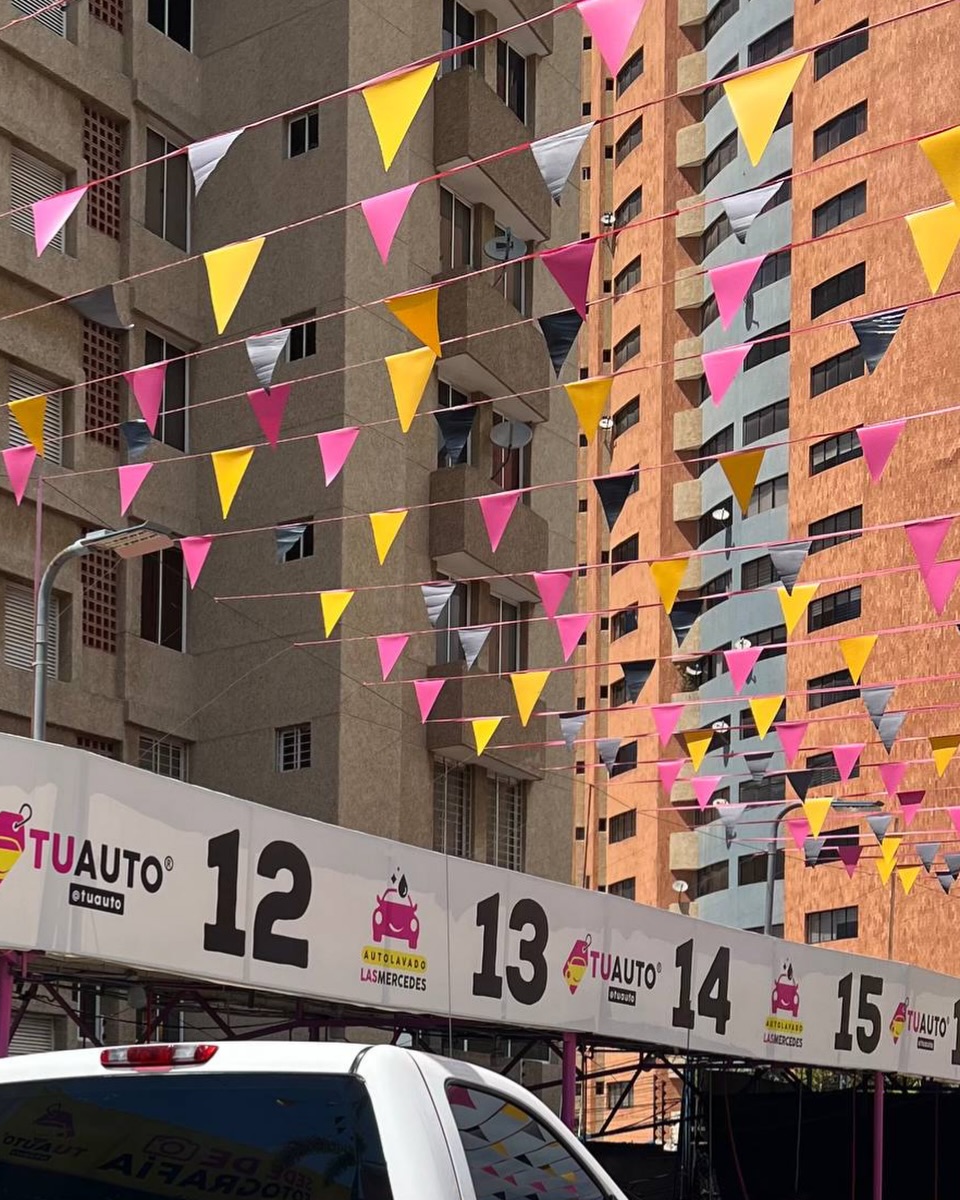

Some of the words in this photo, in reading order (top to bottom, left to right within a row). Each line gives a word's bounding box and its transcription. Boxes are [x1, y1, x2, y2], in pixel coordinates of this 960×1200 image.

[71, 889, 122, 910] @tuauto
[203, 828, 312, 968] 12
[363, 950, 426, 970] AUTOLAVADO
[472, 892, 549, 1005] 13
[672, 938, 731, 1035] 14
[834, 972, 883, 1054] 15
